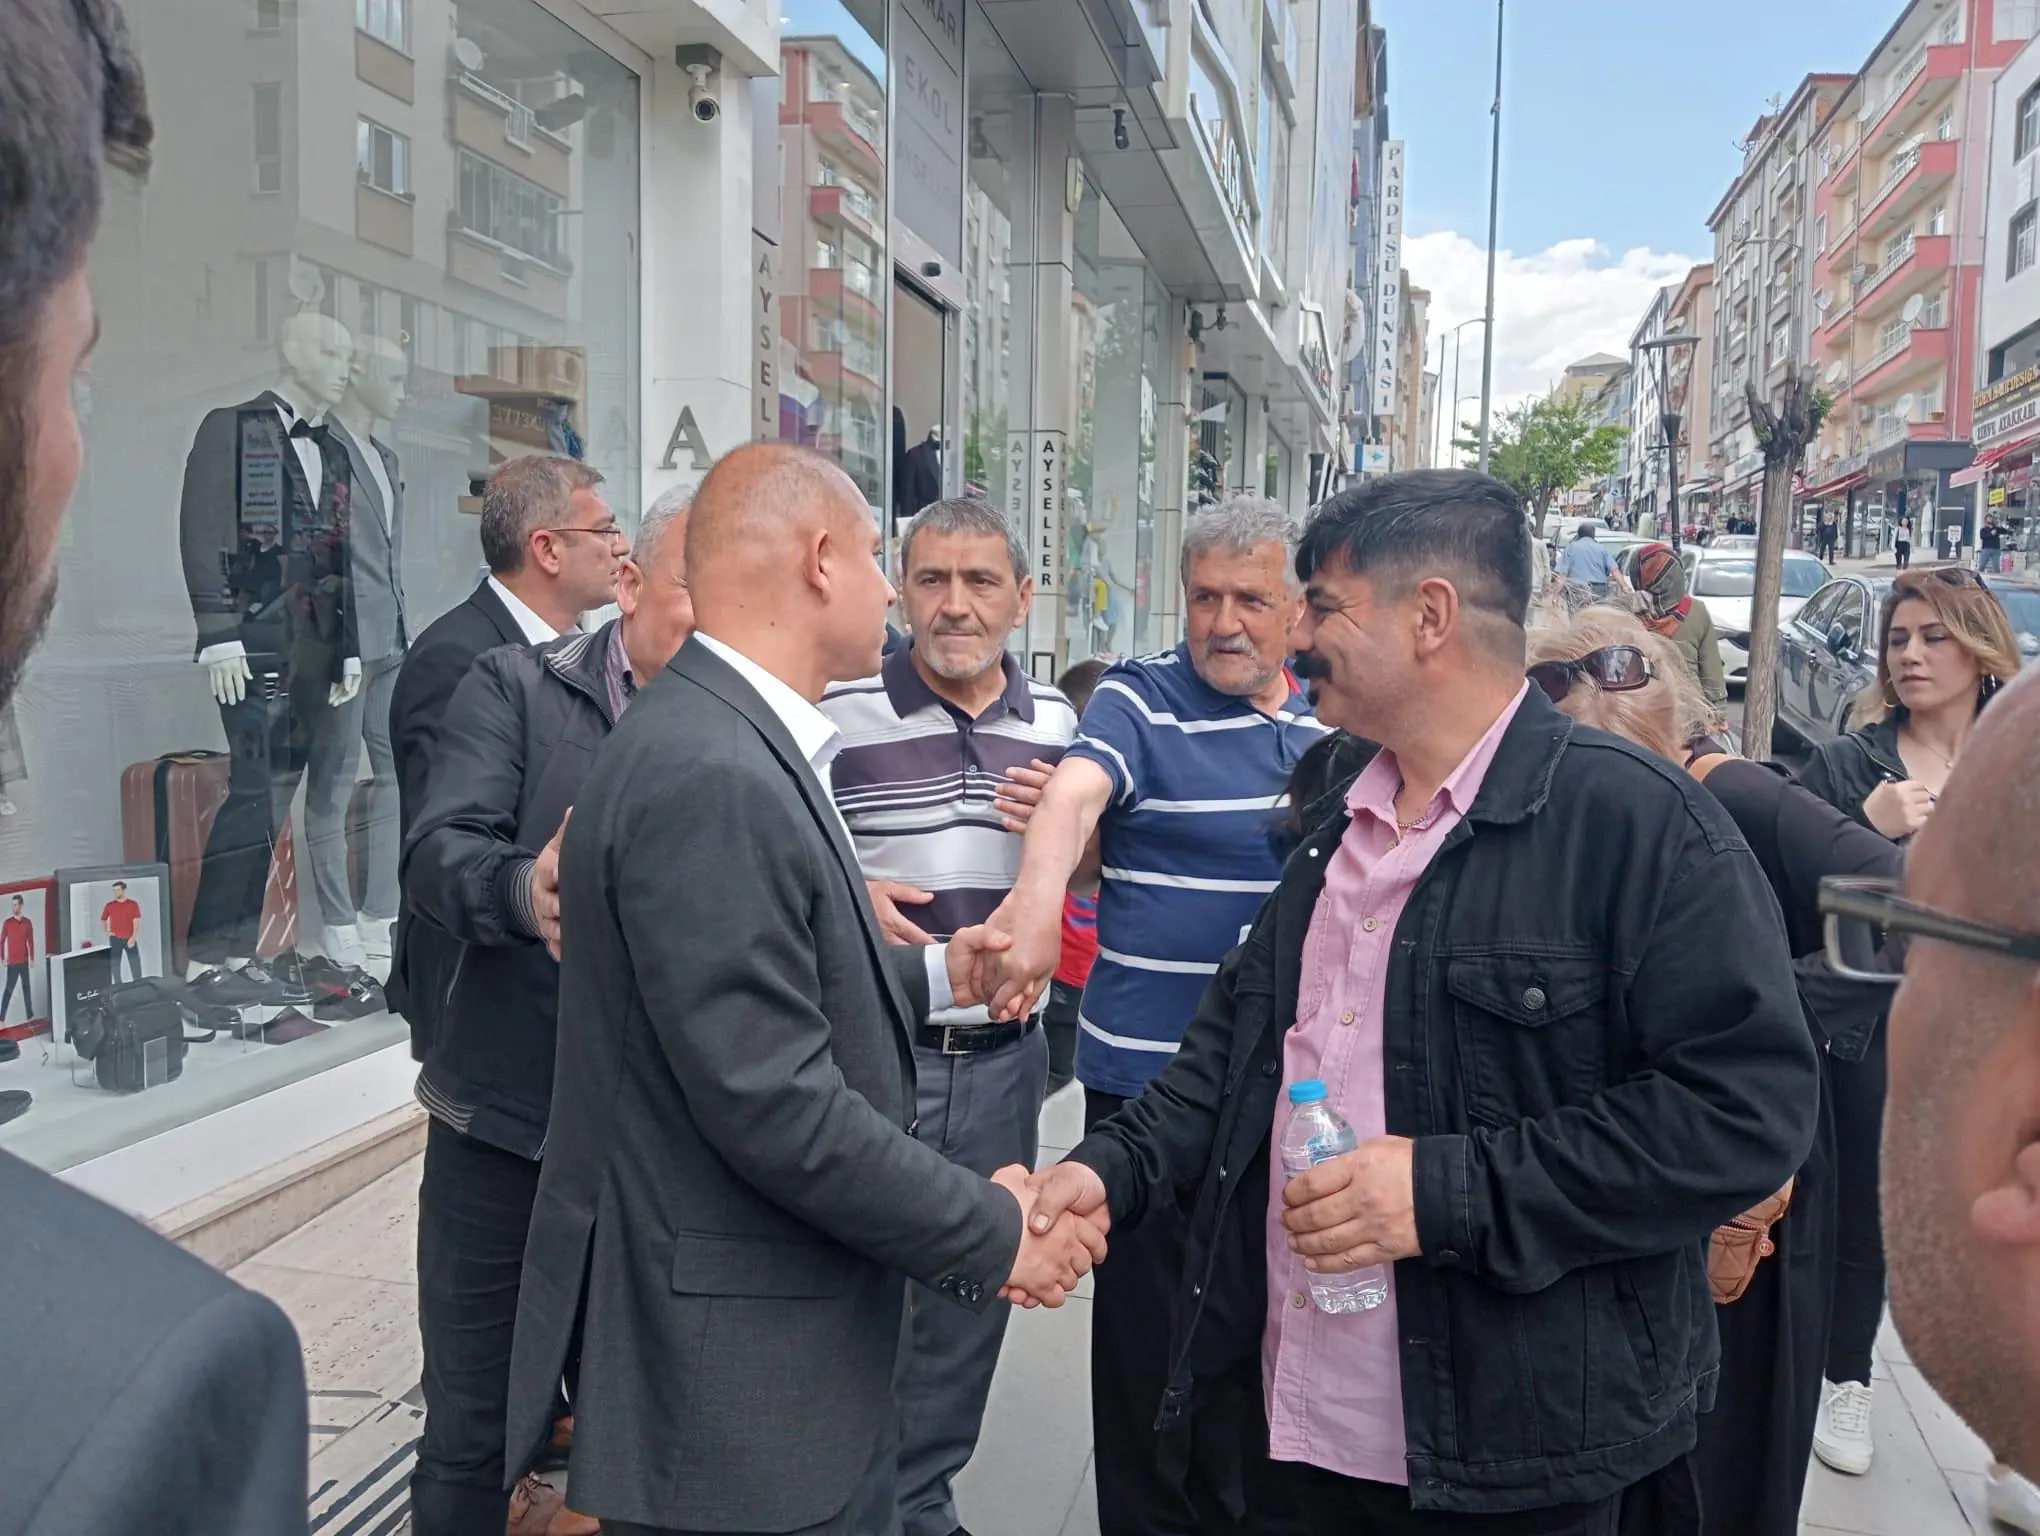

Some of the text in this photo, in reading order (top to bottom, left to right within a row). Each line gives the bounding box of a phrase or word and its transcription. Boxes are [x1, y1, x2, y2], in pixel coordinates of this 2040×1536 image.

[922, 0, 957, 46] RAR
[905, 54, 953, 135] EKOL
[1380, 147, 1401, 407] PARDESÜ DÜNYASI
[758, 253, 773, 442] AYSEL
[657, 405, 715, 469] A
[1041, 440, 1055, 586] AYSELLER
